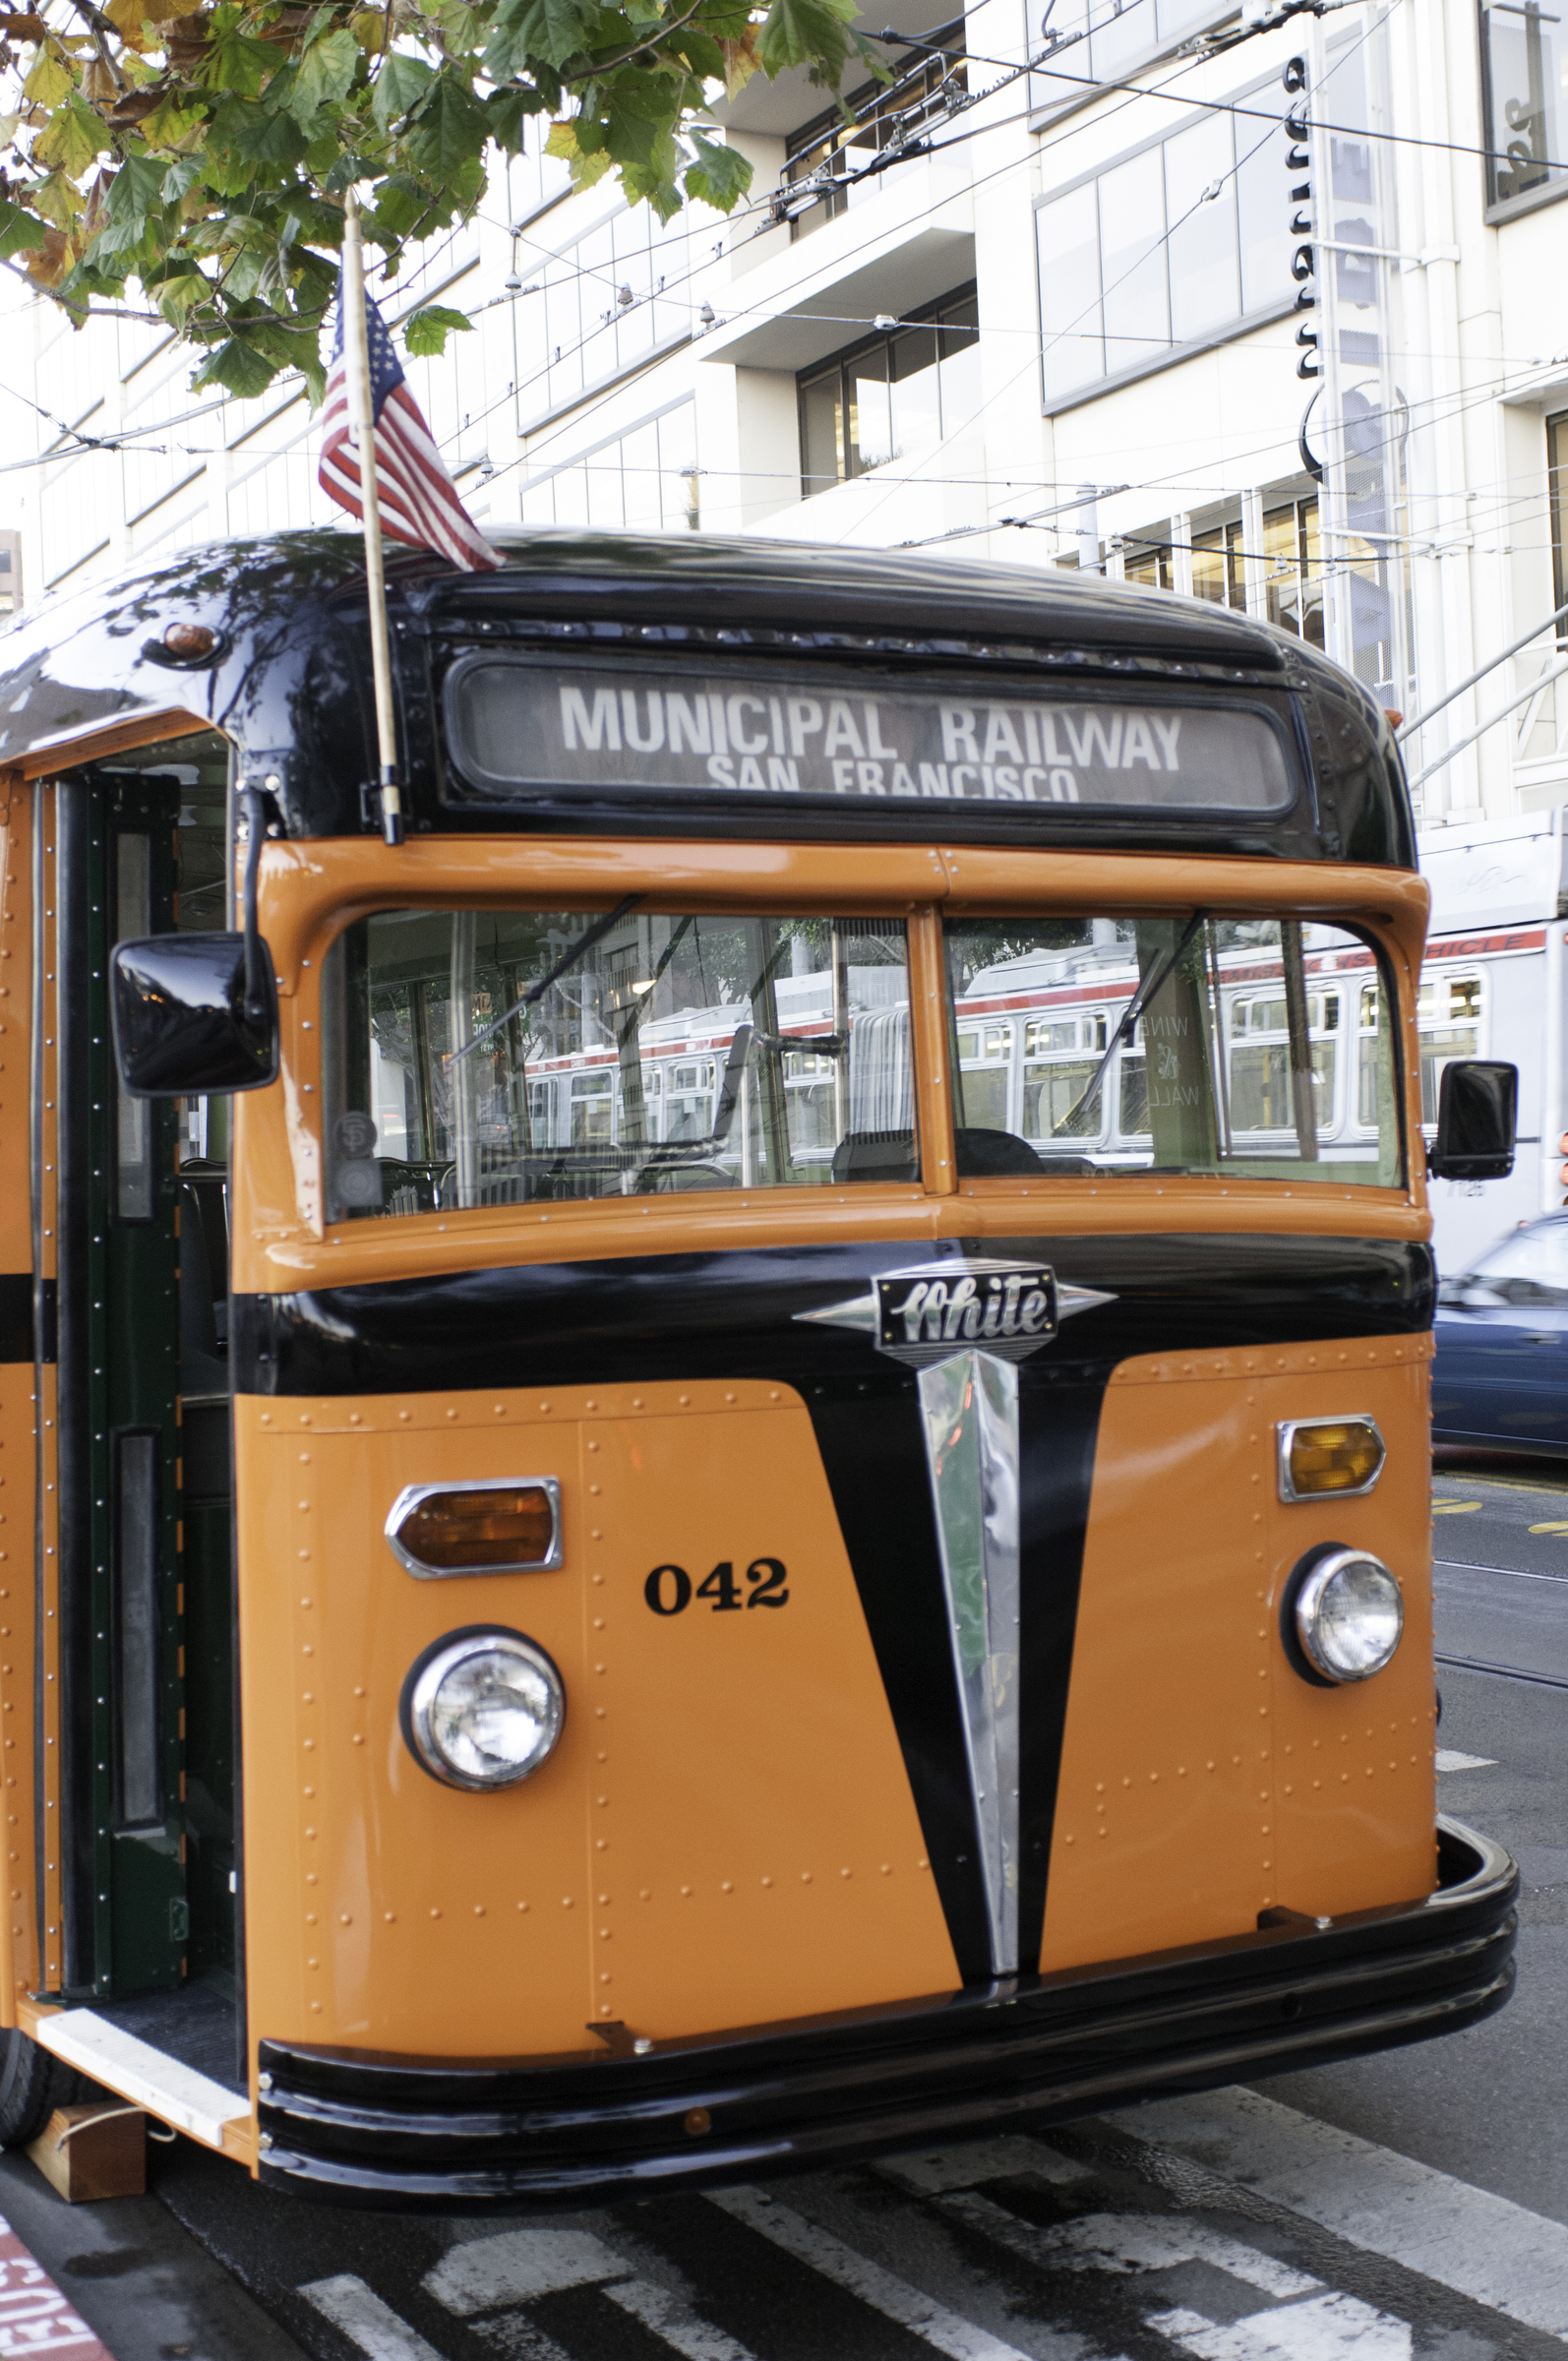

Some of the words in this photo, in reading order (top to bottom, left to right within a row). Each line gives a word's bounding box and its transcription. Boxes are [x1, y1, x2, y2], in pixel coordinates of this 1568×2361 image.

[559, 687, 897, 759] MUNICIPAL
[938, 703, 1181, 771] RAILWAY
[706, 754, 800, 792] SAN
[832, 758, 1080, 803] FRANCISCO
[889, 1276, 1049, 1342] White
[644, 1557, 790, 1616] 042
